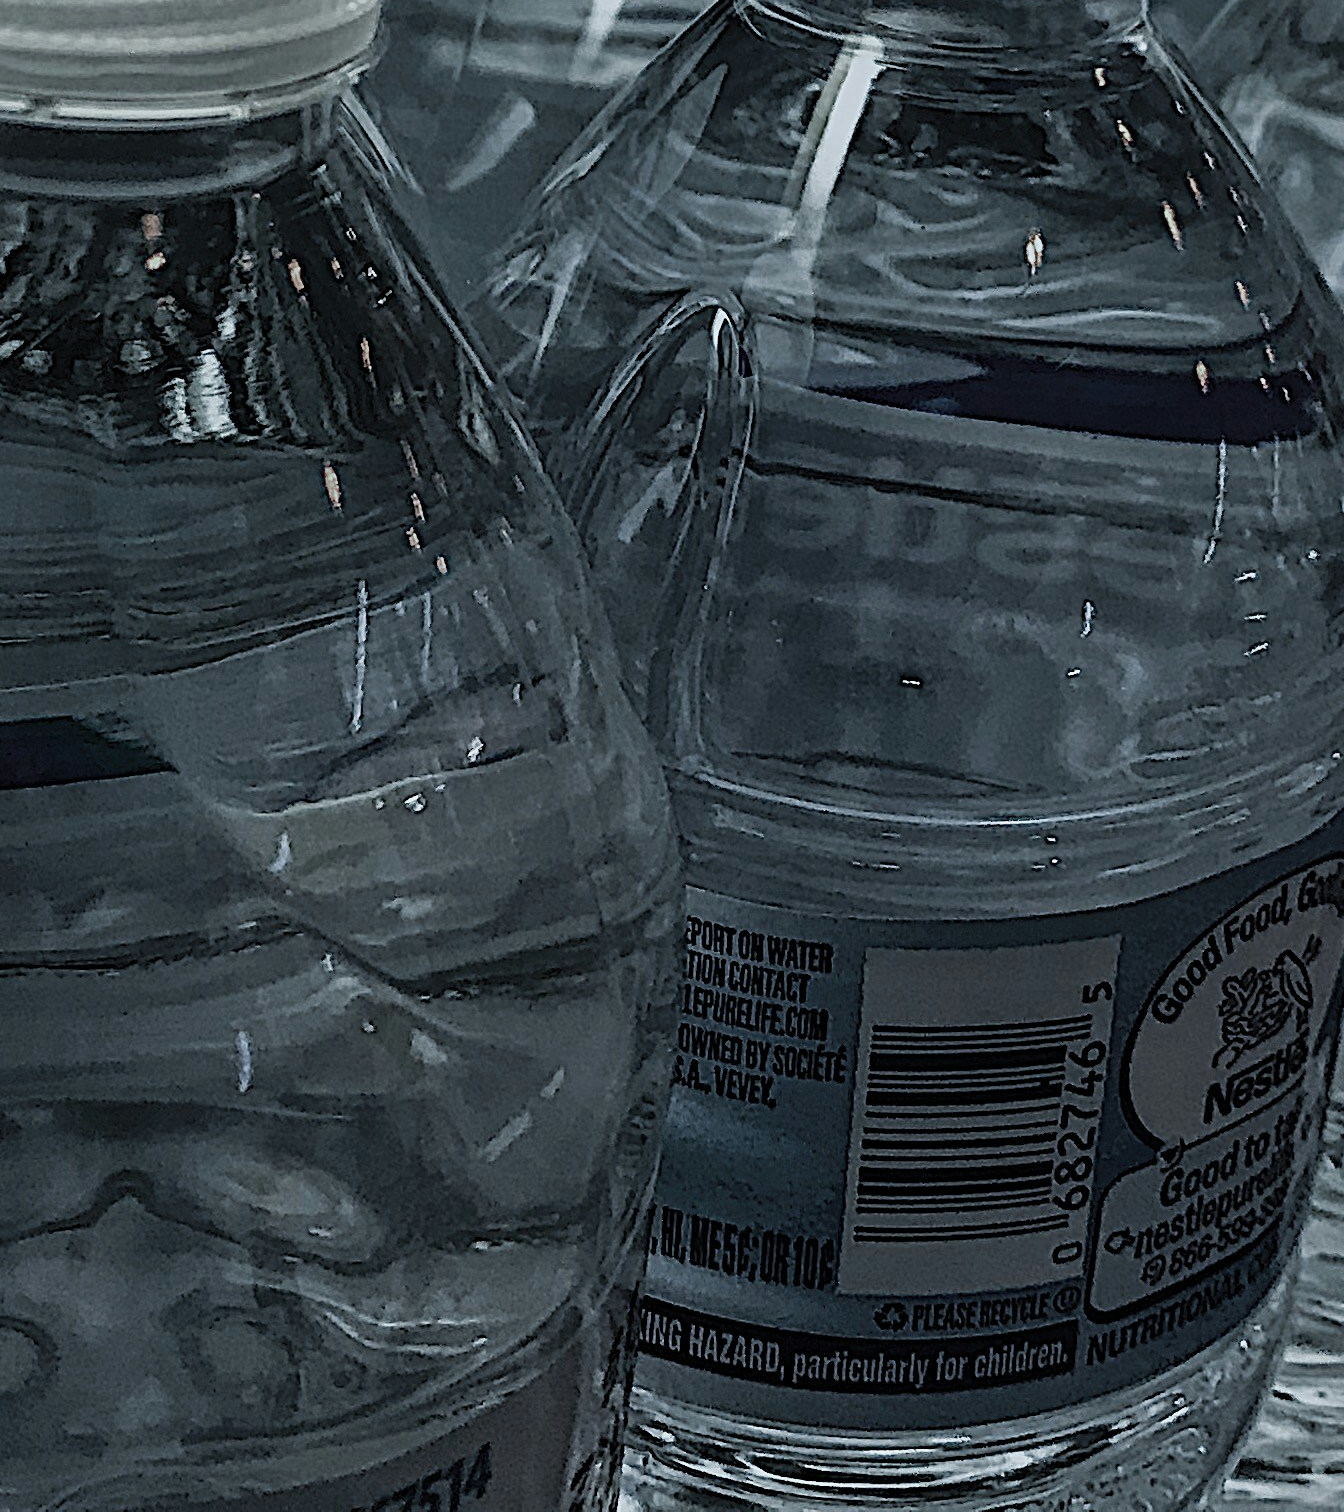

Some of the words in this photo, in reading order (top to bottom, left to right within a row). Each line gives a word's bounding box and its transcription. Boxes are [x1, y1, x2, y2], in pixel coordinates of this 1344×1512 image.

[728, 960, 811, 1003] CONTACT
[737, 928, 765, 963] ON
[766, 934, 834, 974] WATER
[1151, 934, 1222, 1024] Good
[1223, 882, 1293, 955] Food,
[678, 1022, 743, 1066] OWNED
[745, 1039, 772, 1072] BY
[772, 1043, 848, 1084] SOCIÉTÉ
[1159, 1139, 1240, 1207] Good
[1244, 1131, 1270, 1168] to
[760, 1230, 791, 1286] OR
[911, 1300, 978, 1332] PLEASE
[978, 1291, 1051, 1328] RECYCLE
[1086, 1269, 1246, 1366] NUTRITIONAL
[689, 1323, 785, 1382] HAZARD,
[792, 1351, 929, 1389] particularly
[935, 1350, 969, 1381] for
[974, 1340, 1069, 1379] children.
